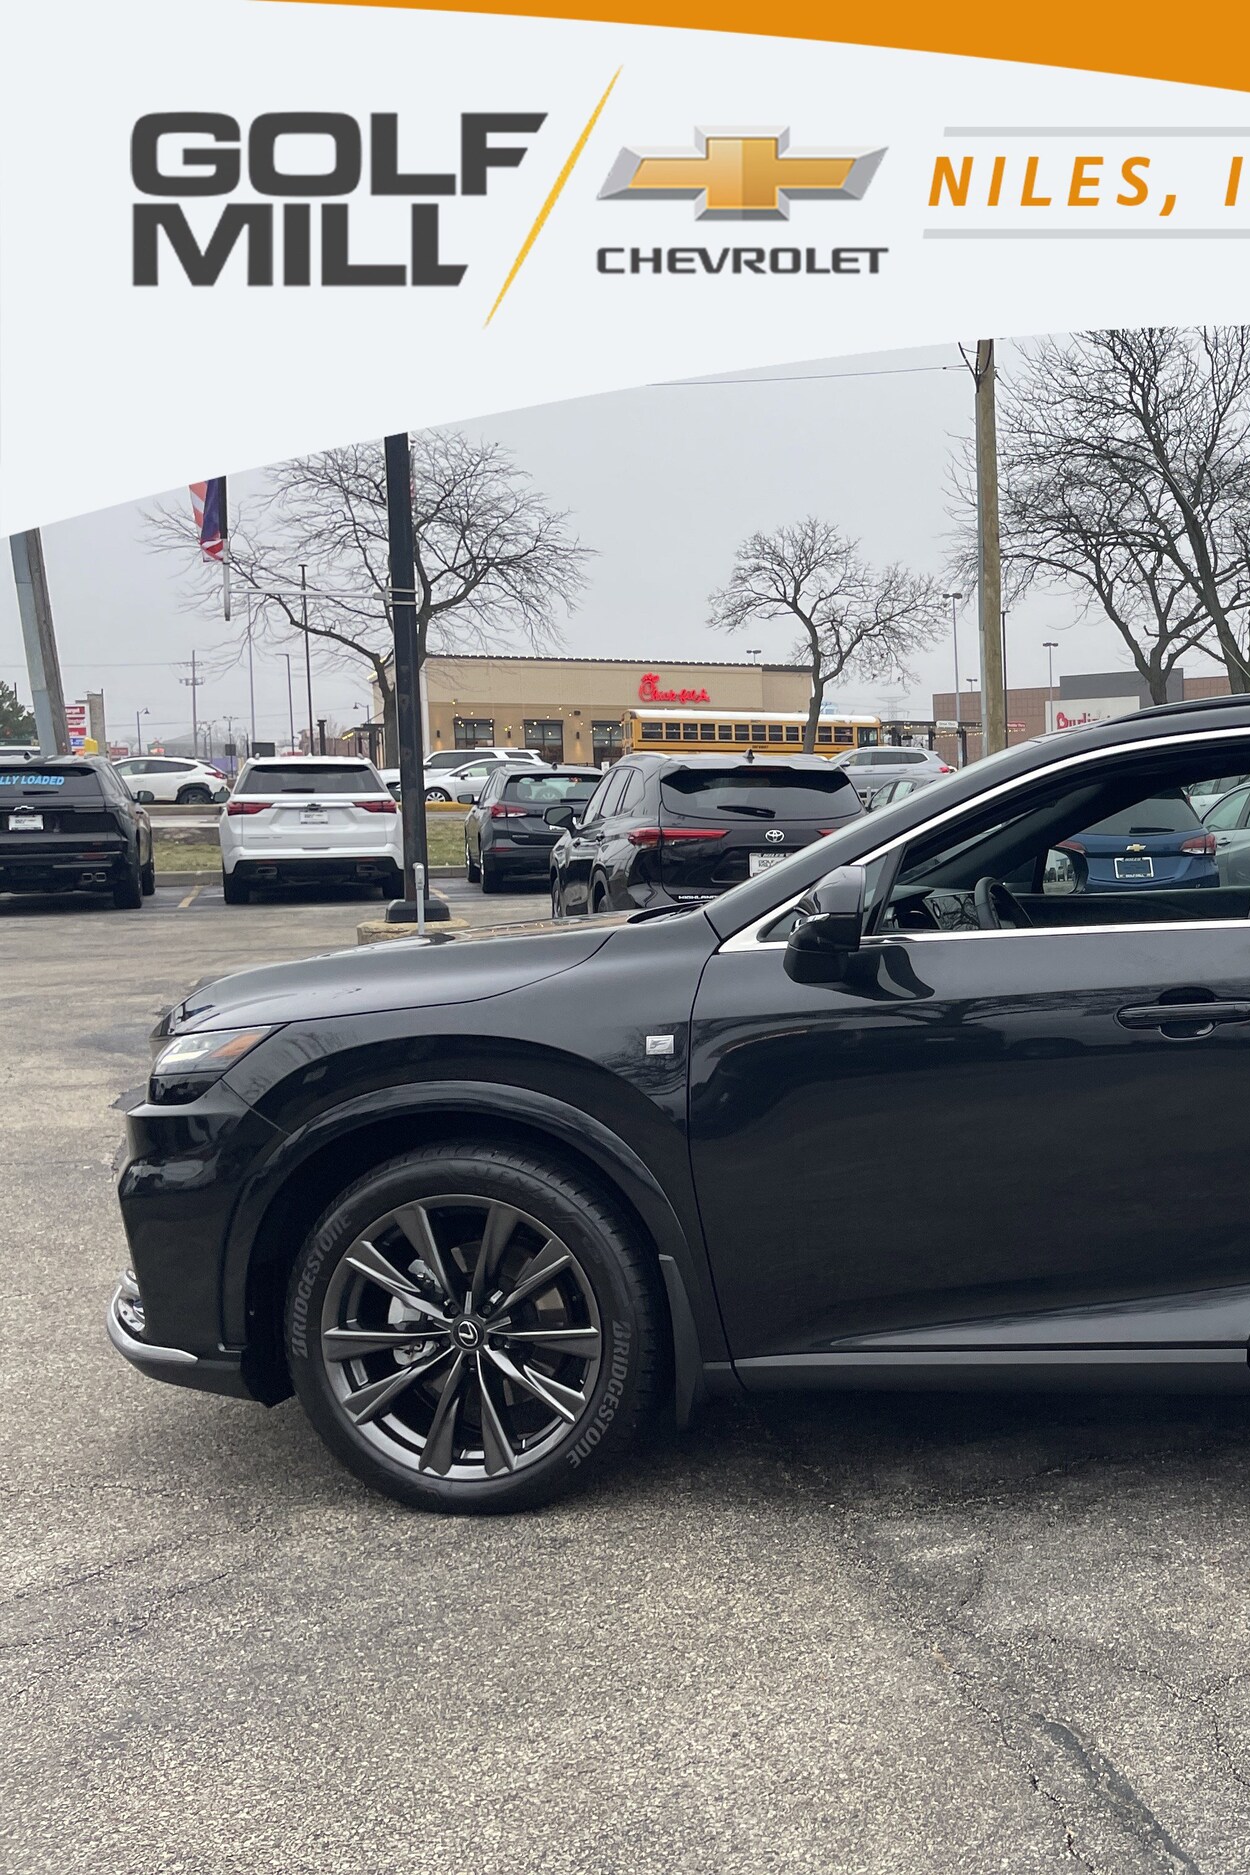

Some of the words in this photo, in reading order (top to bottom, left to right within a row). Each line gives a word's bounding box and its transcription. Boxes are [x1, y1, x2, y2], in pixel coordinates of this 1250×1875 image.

[21, 776, 65, 785] LOADED
[291, 1213, 352, 1360] BRIDGESTONE
[566, 1320, 632, 1469] BRIDGESTONE
